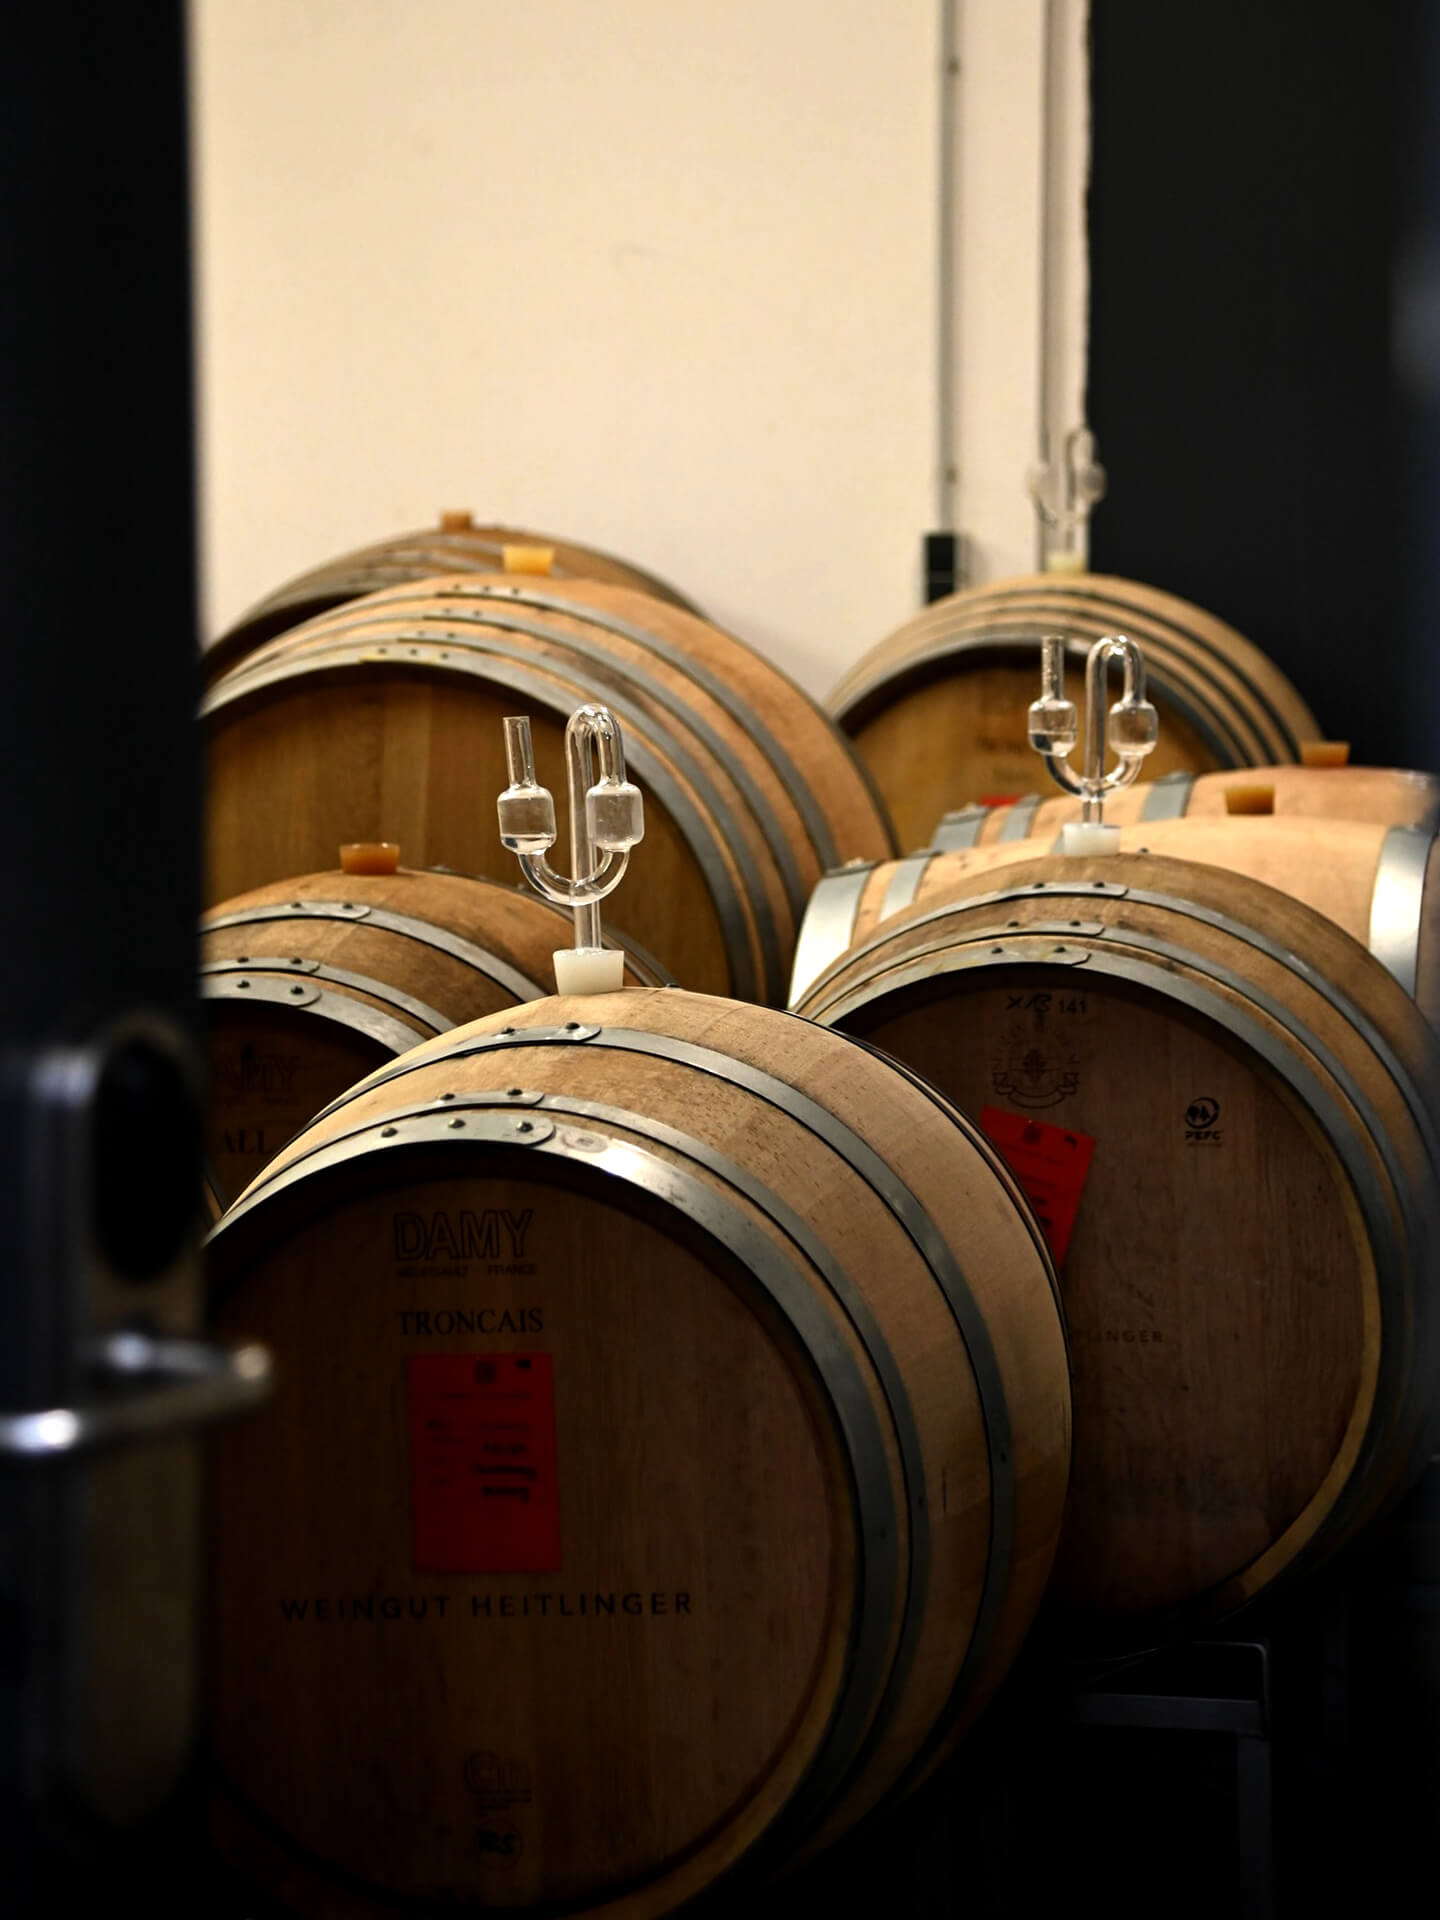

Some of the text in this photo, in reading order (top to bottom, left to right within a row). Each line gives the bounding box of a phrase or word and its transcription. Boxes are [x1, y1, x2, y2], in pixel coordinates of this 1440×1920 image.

[1058, 999, 1087, 1014] 141
[1185, 1130, 1222, 1141] PEFC
[393, 1208, 535, 1261] DAMY
[396, 1307, 544, 1335] TRONCAIS
[281, 1591, 692, 1621] WEINGUT HEITLINGER
